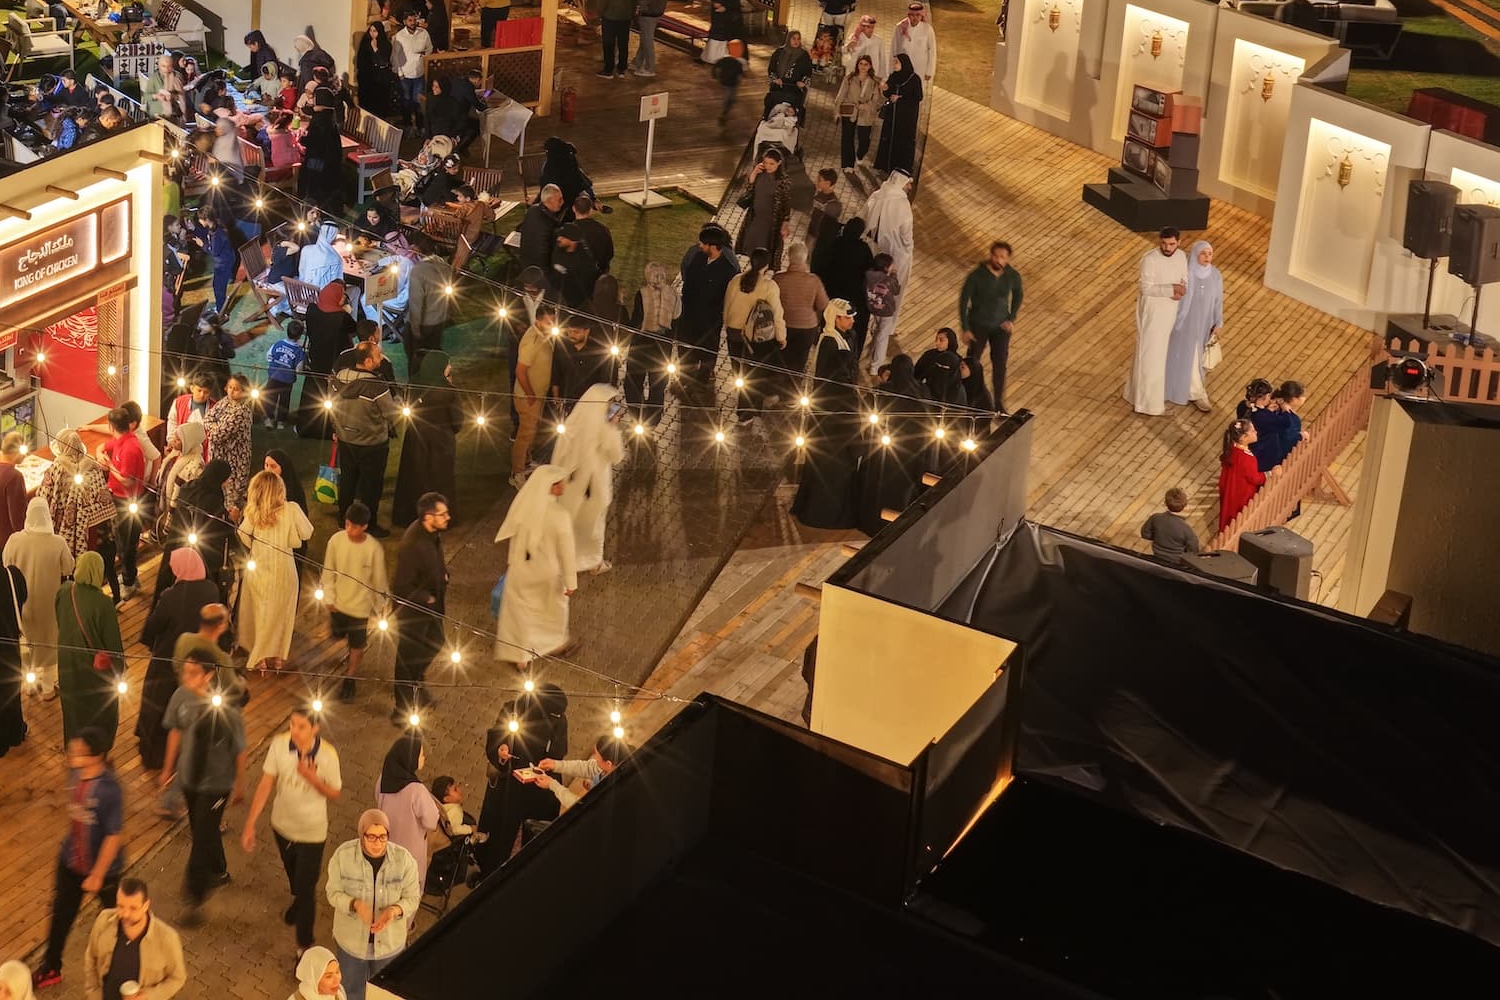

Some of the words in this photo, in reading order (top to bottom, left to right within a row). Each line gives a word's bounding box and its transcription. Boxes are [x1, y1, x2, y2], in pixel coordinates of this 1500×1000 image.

[14, 272, 35, 290] KING
[35, 267, 46, 281] OF
[46, 254, 78, 276] CHICKEN
